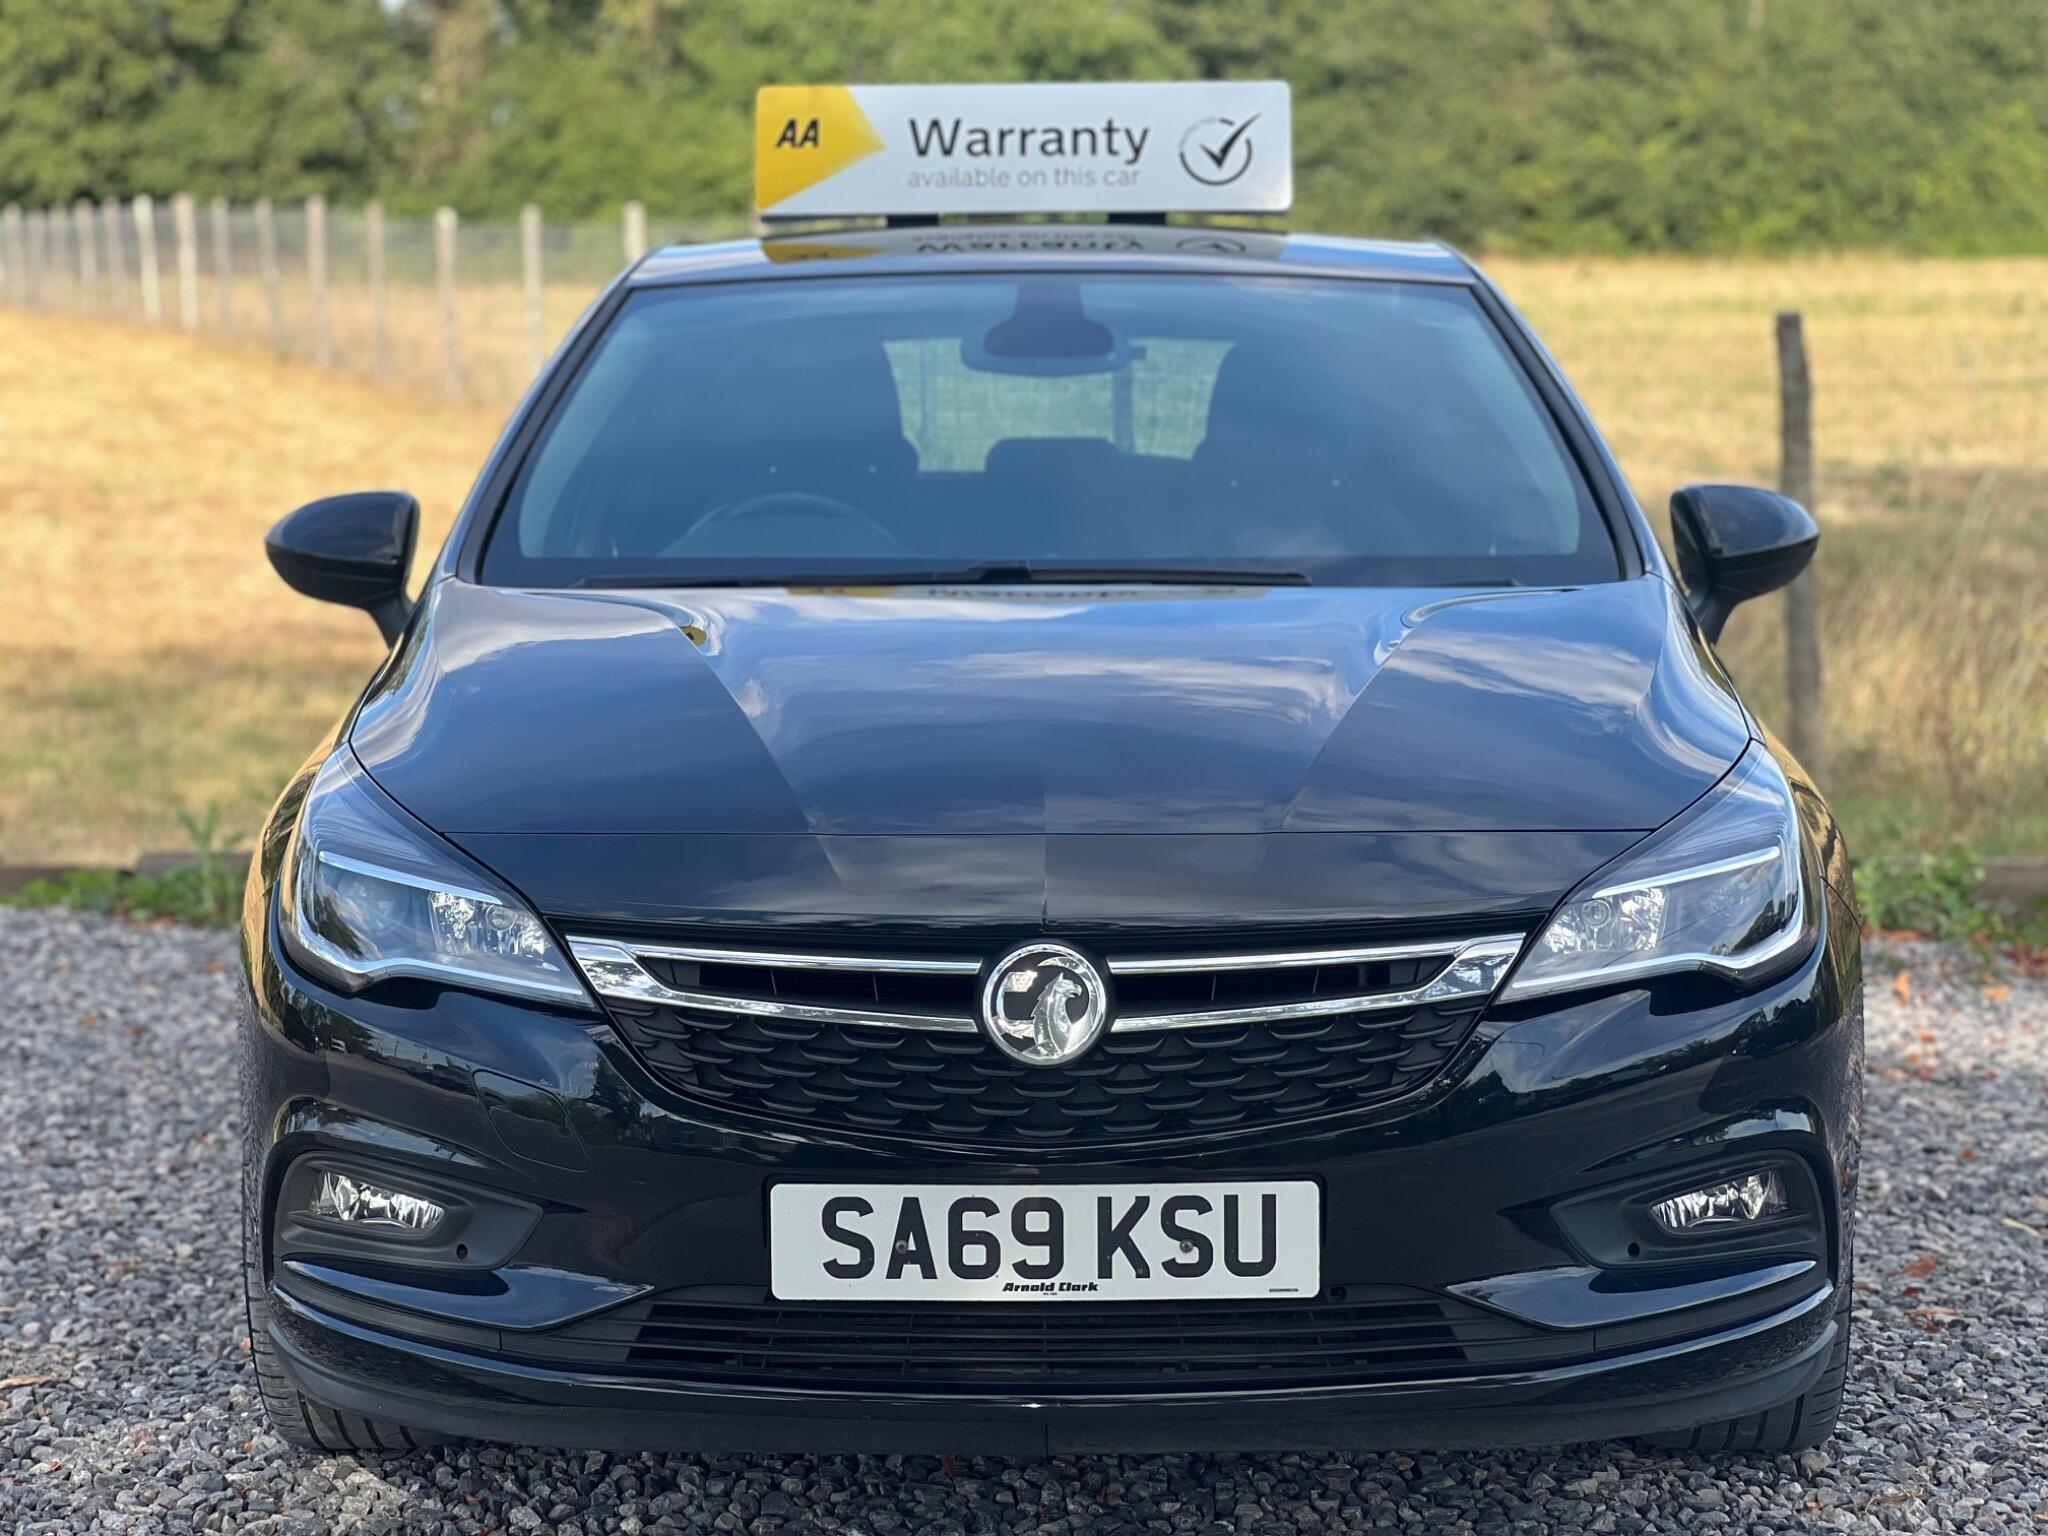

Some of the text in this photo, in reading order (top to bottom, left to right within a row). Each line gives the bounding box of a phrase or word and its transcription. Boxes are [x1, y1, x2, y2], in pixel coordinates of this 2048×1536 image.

[776, 119, 820, 149] AA
[909, 118, 1149, 166] Warranty
[907, 168, 1141, 188] available on this car
[821, 1193, 1278, 1280] SA69 KSU
[1001, 1281, 1099, 1292] Arnold Clark
